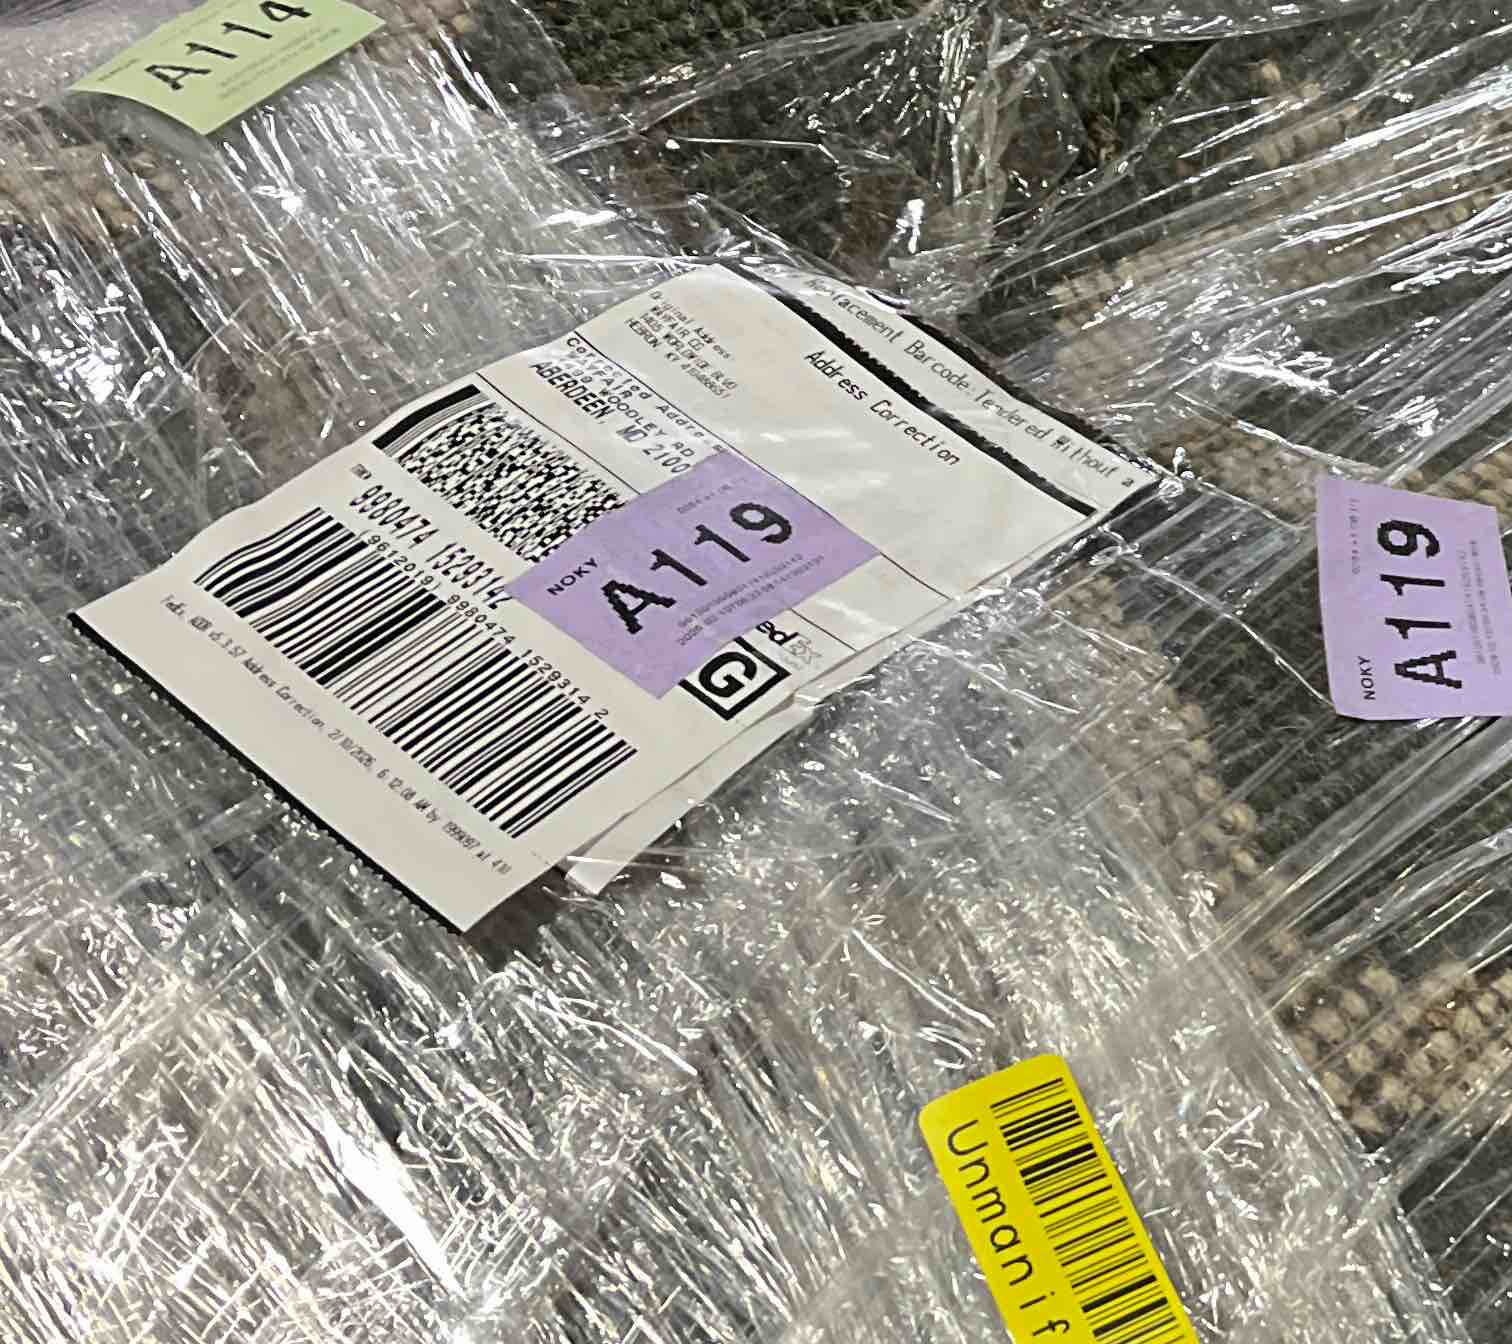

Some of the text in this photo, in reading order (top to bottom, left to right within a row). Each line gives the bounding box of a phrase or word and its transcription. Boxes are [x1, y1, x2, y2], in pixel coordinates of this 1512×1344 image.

[144, 0, 312, 91] A114
[566, 337, 653, 400] Corrected
[599, 387, 668, 437] WOODLEY
[804, 348, 961, 467] Address Correction
[616, 424, 648, 443] MD
[642, 443, 691, 473] 2100
[972, 388, 1053, 442] Tendered
[1121, 477, 1135, 489] a
[350, 484, 513, 610] 9980474 15293142
[548, 557, 600, 596] NOKY
[601, 502, 793, 635] A119
[358, 528, 609, 720] (9612019) 9980474 1529314 2
[1377, 519, 1463, 689] A119
[698, 651, 758, 698] G
[1357, 655, 1377, 700] NOKY
